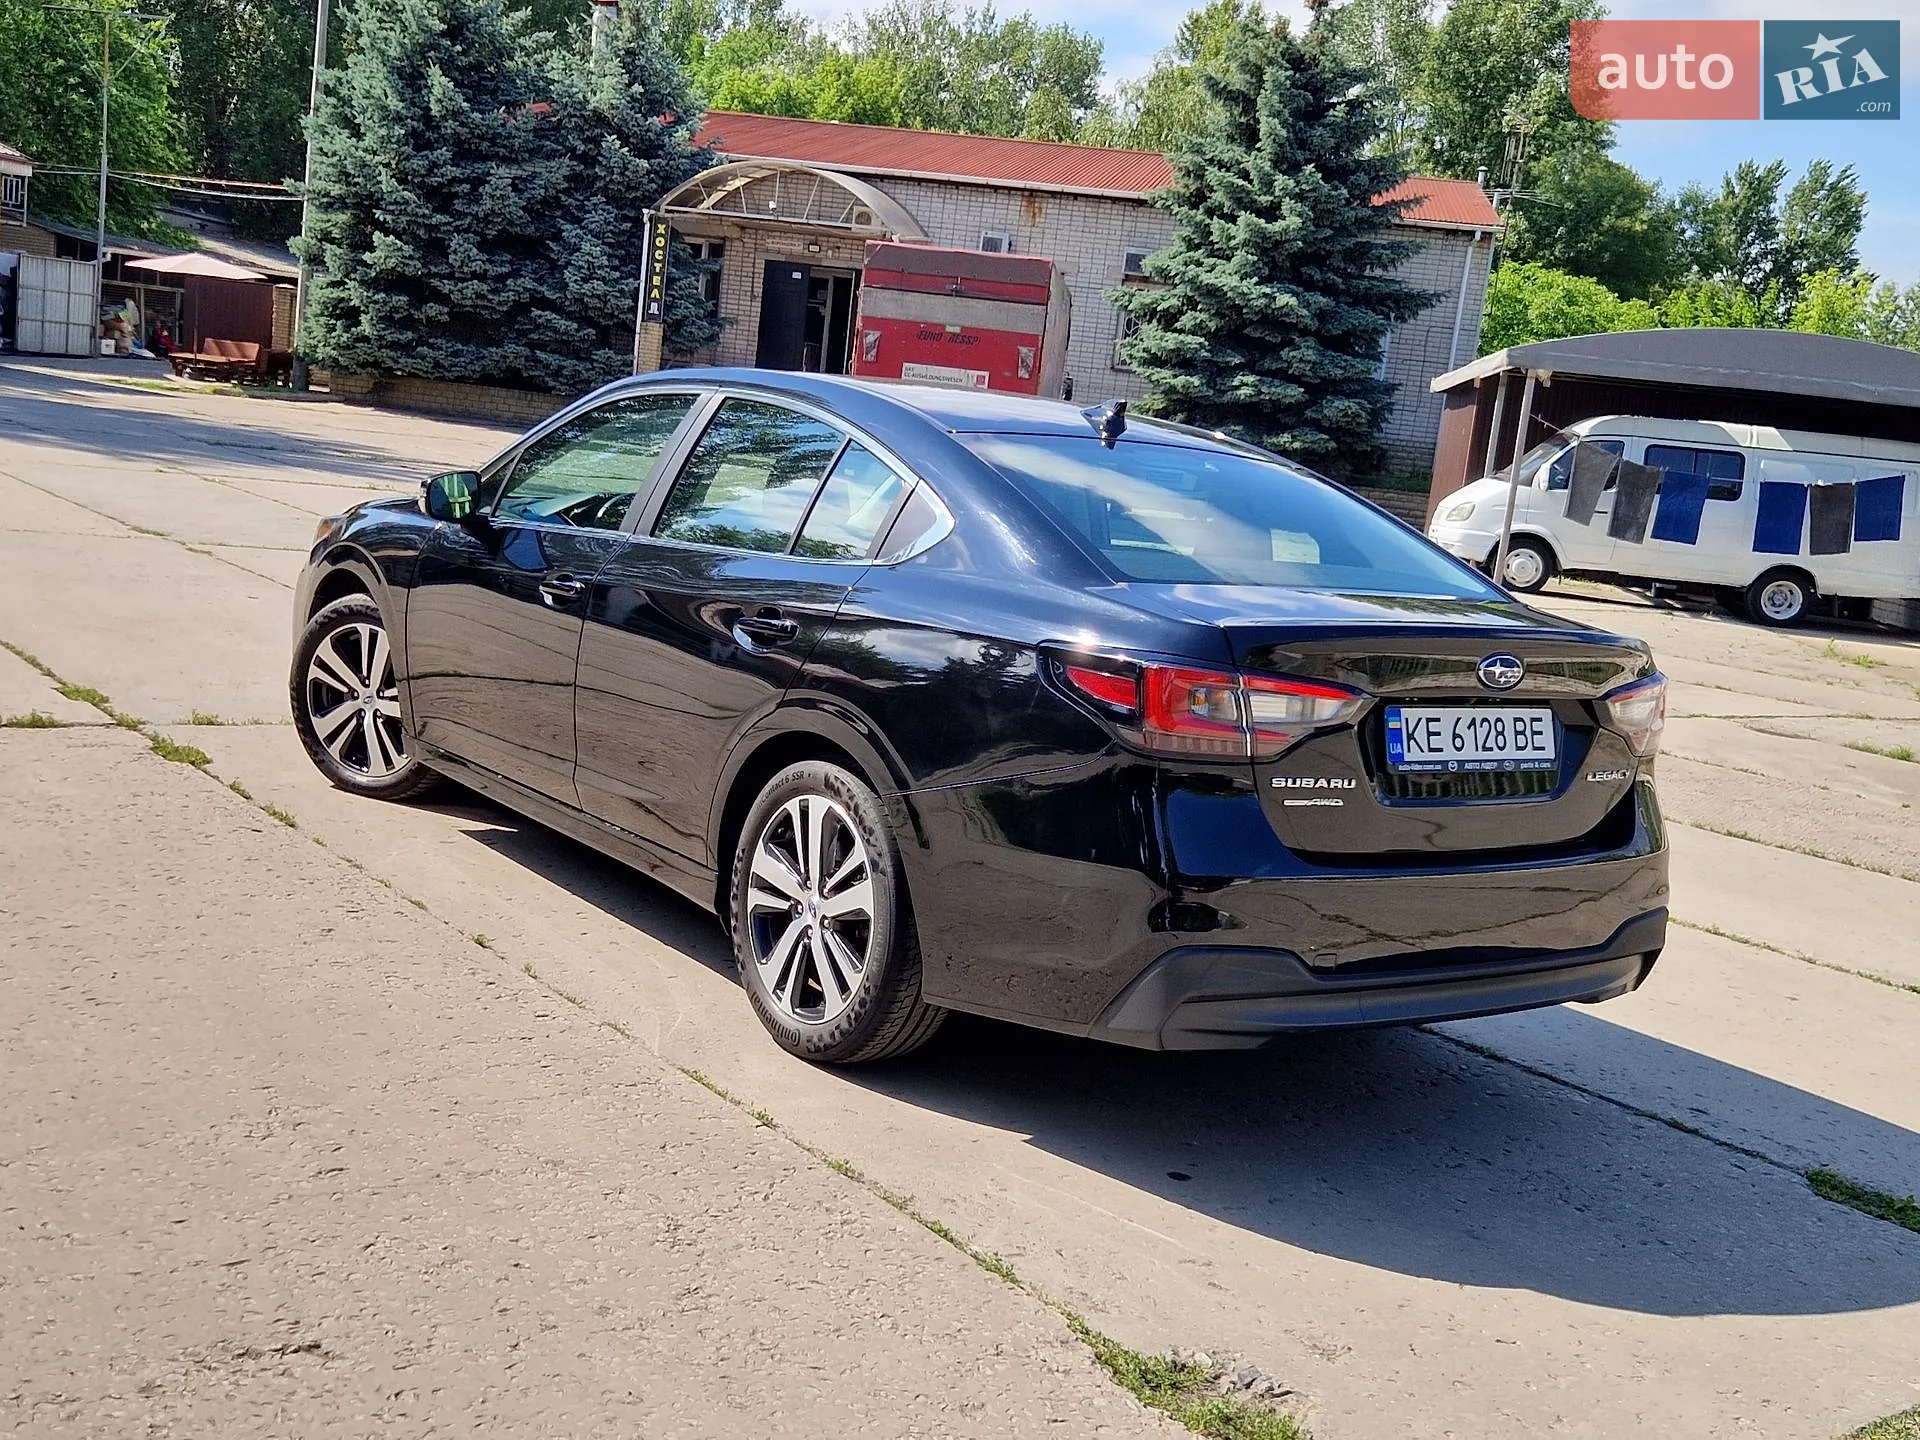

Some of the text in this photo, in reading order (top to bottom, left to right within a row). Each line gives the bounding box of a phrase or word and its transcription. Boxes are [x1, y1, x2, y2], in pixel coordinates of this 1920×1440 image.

[650, 223, 667, 299] ХОСТЕЛ
[1405, 716, 1546, 753] KE 6128 BE
[1389, 743, 1402, 754] UA
[791, 770, 805, 782] SSR
[1586, 769, 1630, 782] LEGACY
[1271, 777, 1357, 789] SUBARU
[1307, 798, 1344, 806] AWD
[750, 991, 801, 1048] Continental
